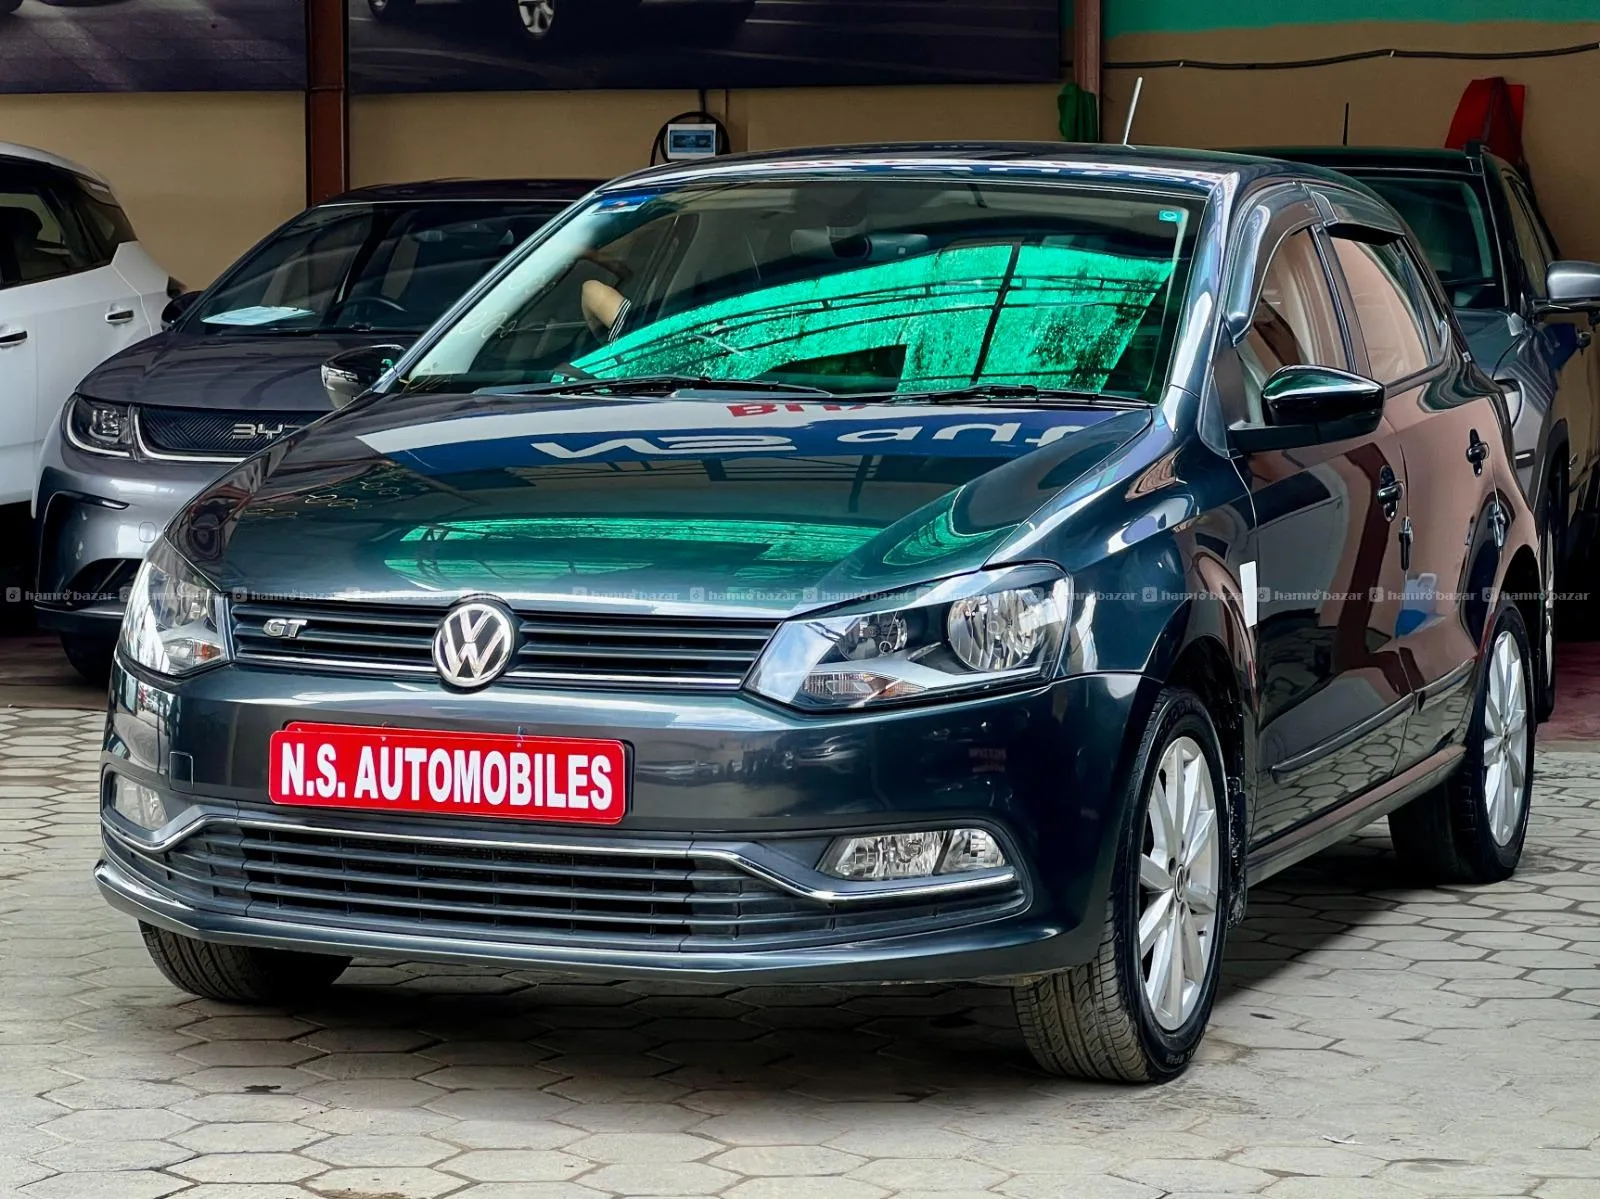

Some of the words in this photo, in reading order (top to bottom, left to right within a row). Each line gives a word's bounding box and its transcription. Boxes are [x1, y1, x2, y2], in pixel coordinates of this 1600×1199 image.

[262, 618, 308, 639] GT
[280, 741, 346, 799] N.S.
[353, 744, 613, 811] AUTOMOBILES
